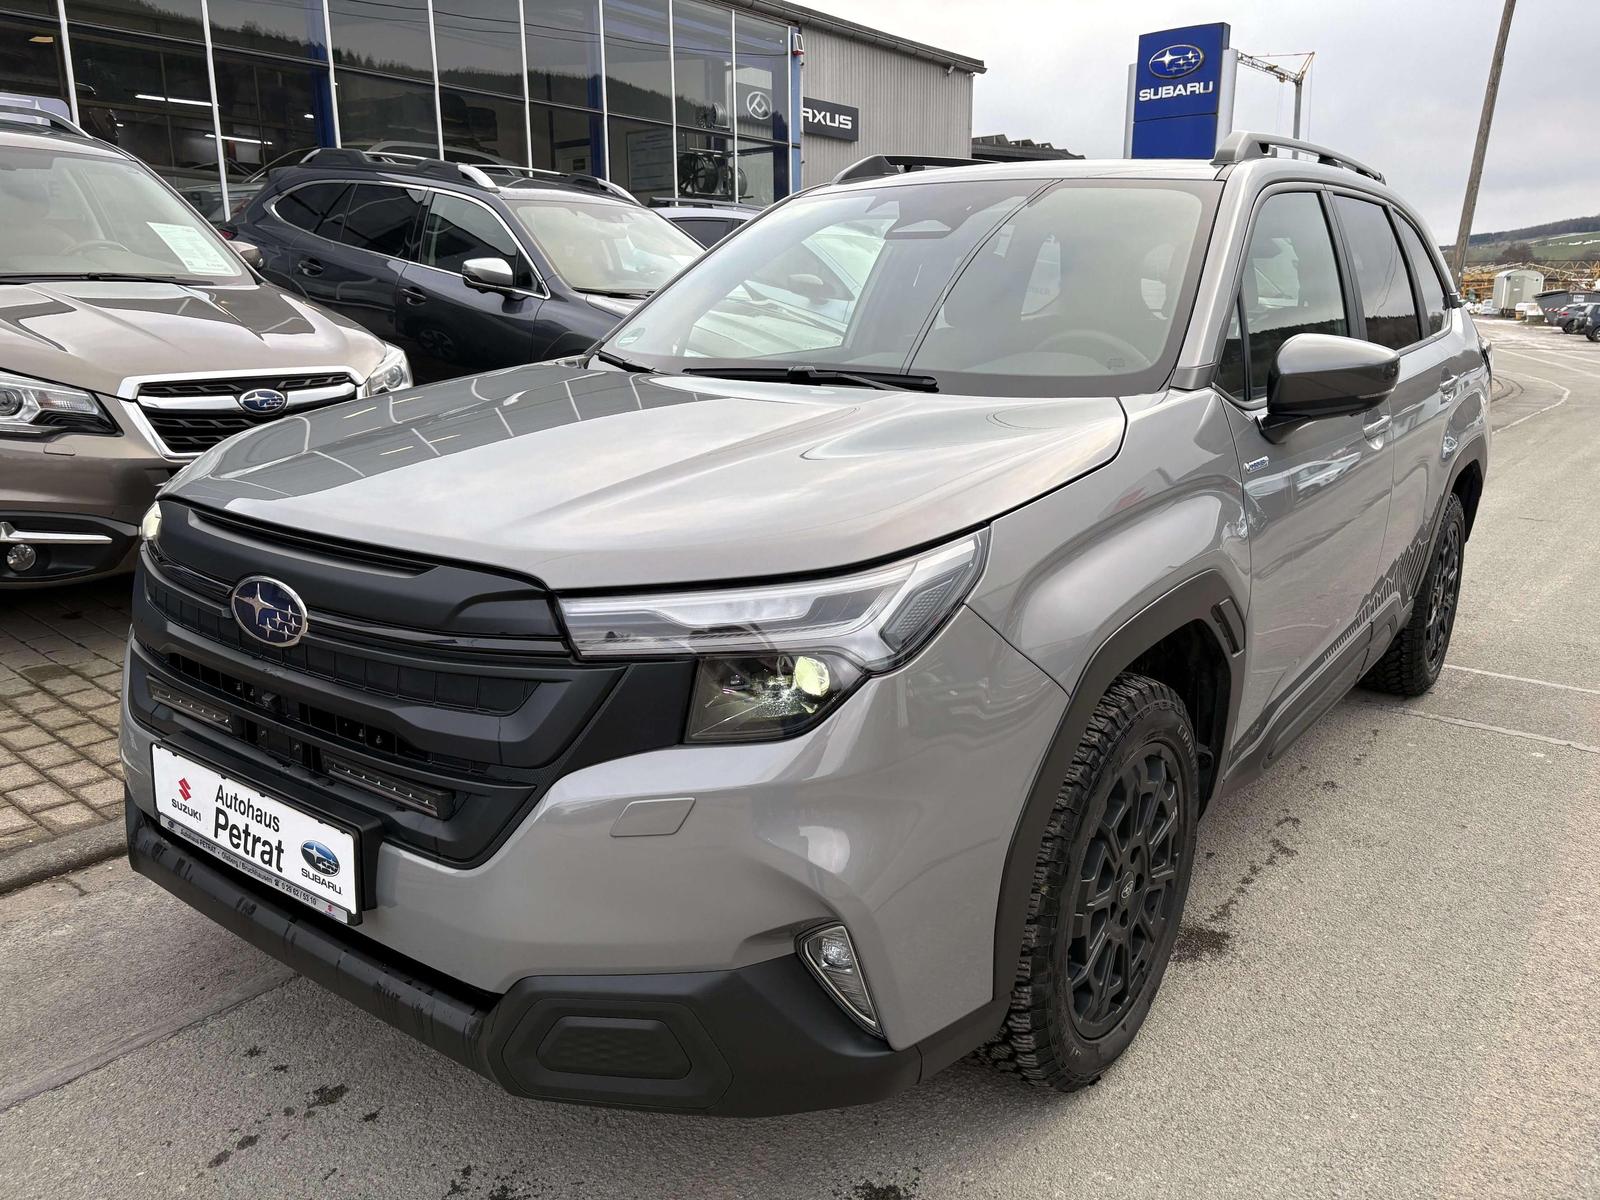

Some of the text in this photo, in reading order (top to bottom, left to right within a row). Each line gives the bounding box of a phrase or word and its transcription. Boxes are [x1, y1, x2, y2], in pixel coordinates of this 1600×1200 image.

[1139, 81, 1213, 101] SUBARU
[171, 798, 201, 822] SUZUKI
[215, 784, 280, 832] Autohaus
[214, 806, 284, 873] Petrat
[301, 867, 342, 895] SUBARU
